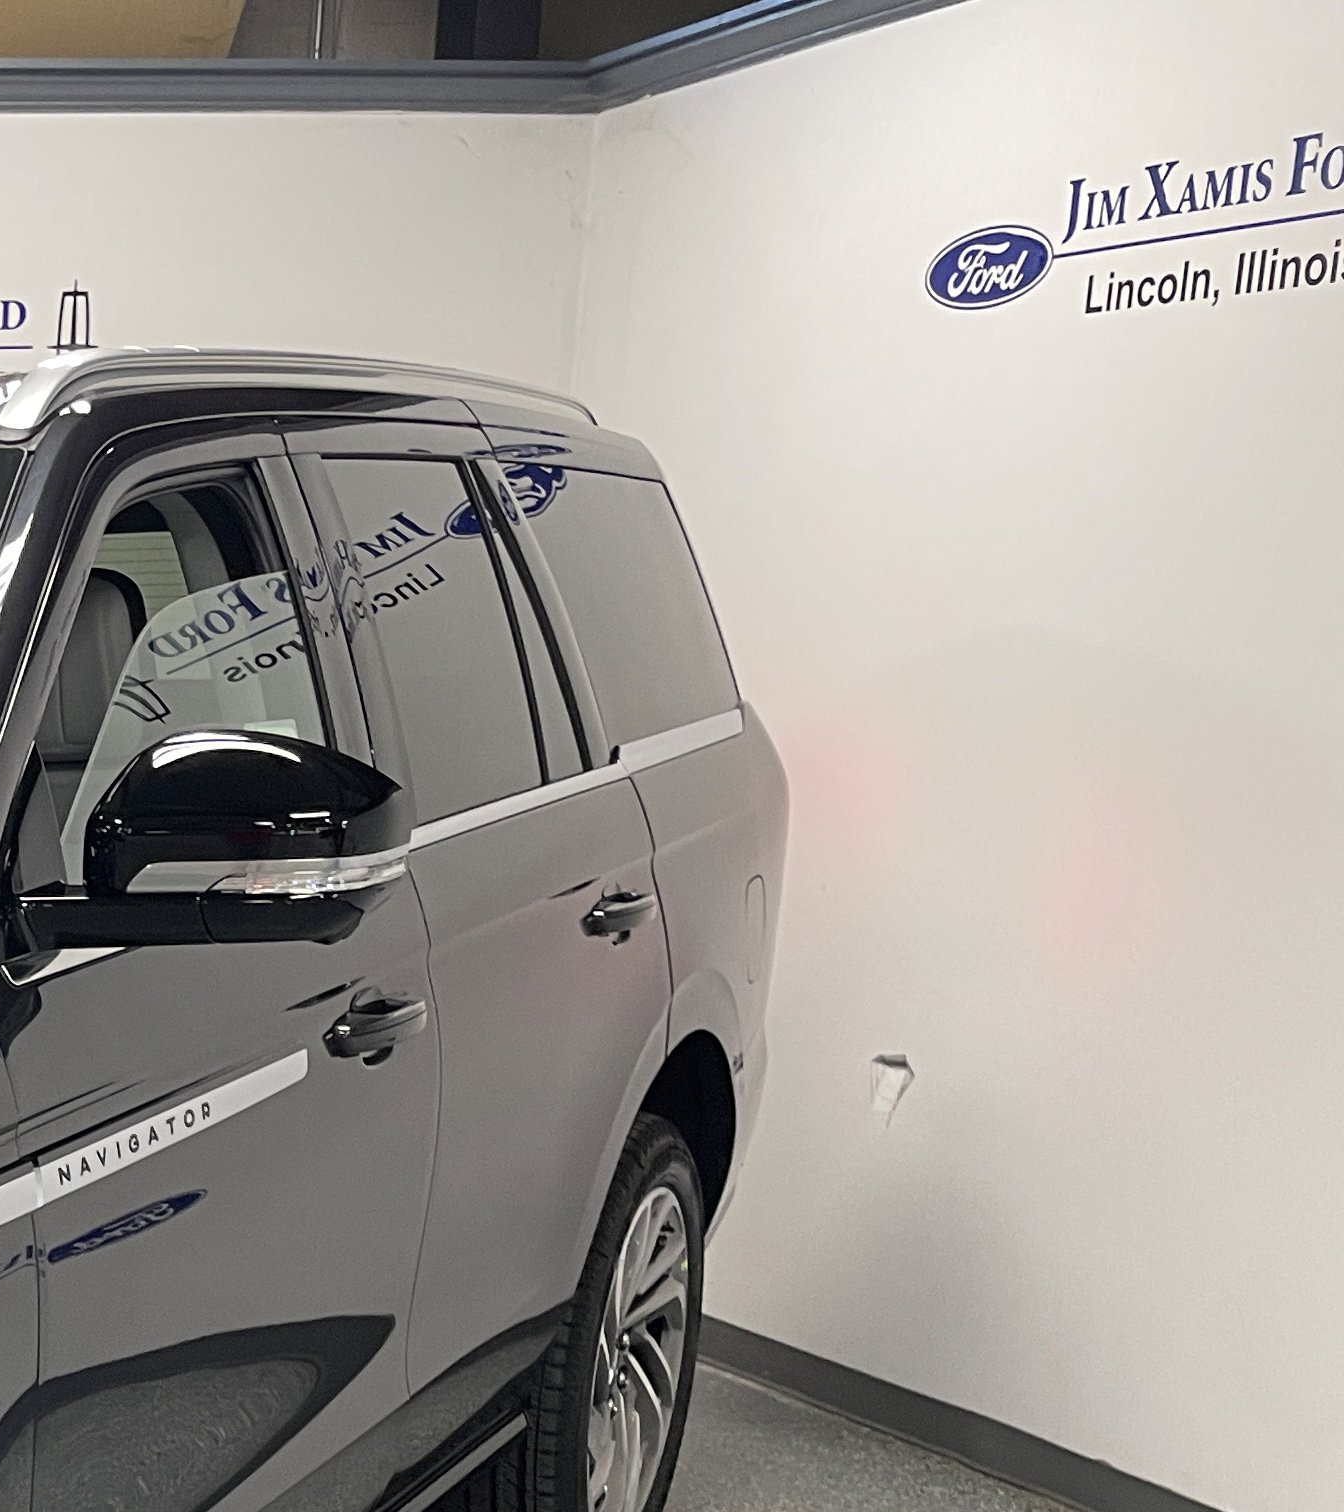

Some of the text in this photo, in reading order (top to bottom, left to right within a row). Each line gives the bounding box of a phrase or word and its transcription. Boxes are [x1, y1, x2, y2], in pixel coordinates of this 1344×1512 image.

[1062, 178, 1130, 244] JIM
[1137, 158, 1274, 221] XAMIS
[947, 241, 1029, 297] Ford
[1084, 239, 1344, 314] Lincoln, Illinoi
[57, 1101, 212, 1185] NAVIGATOR
